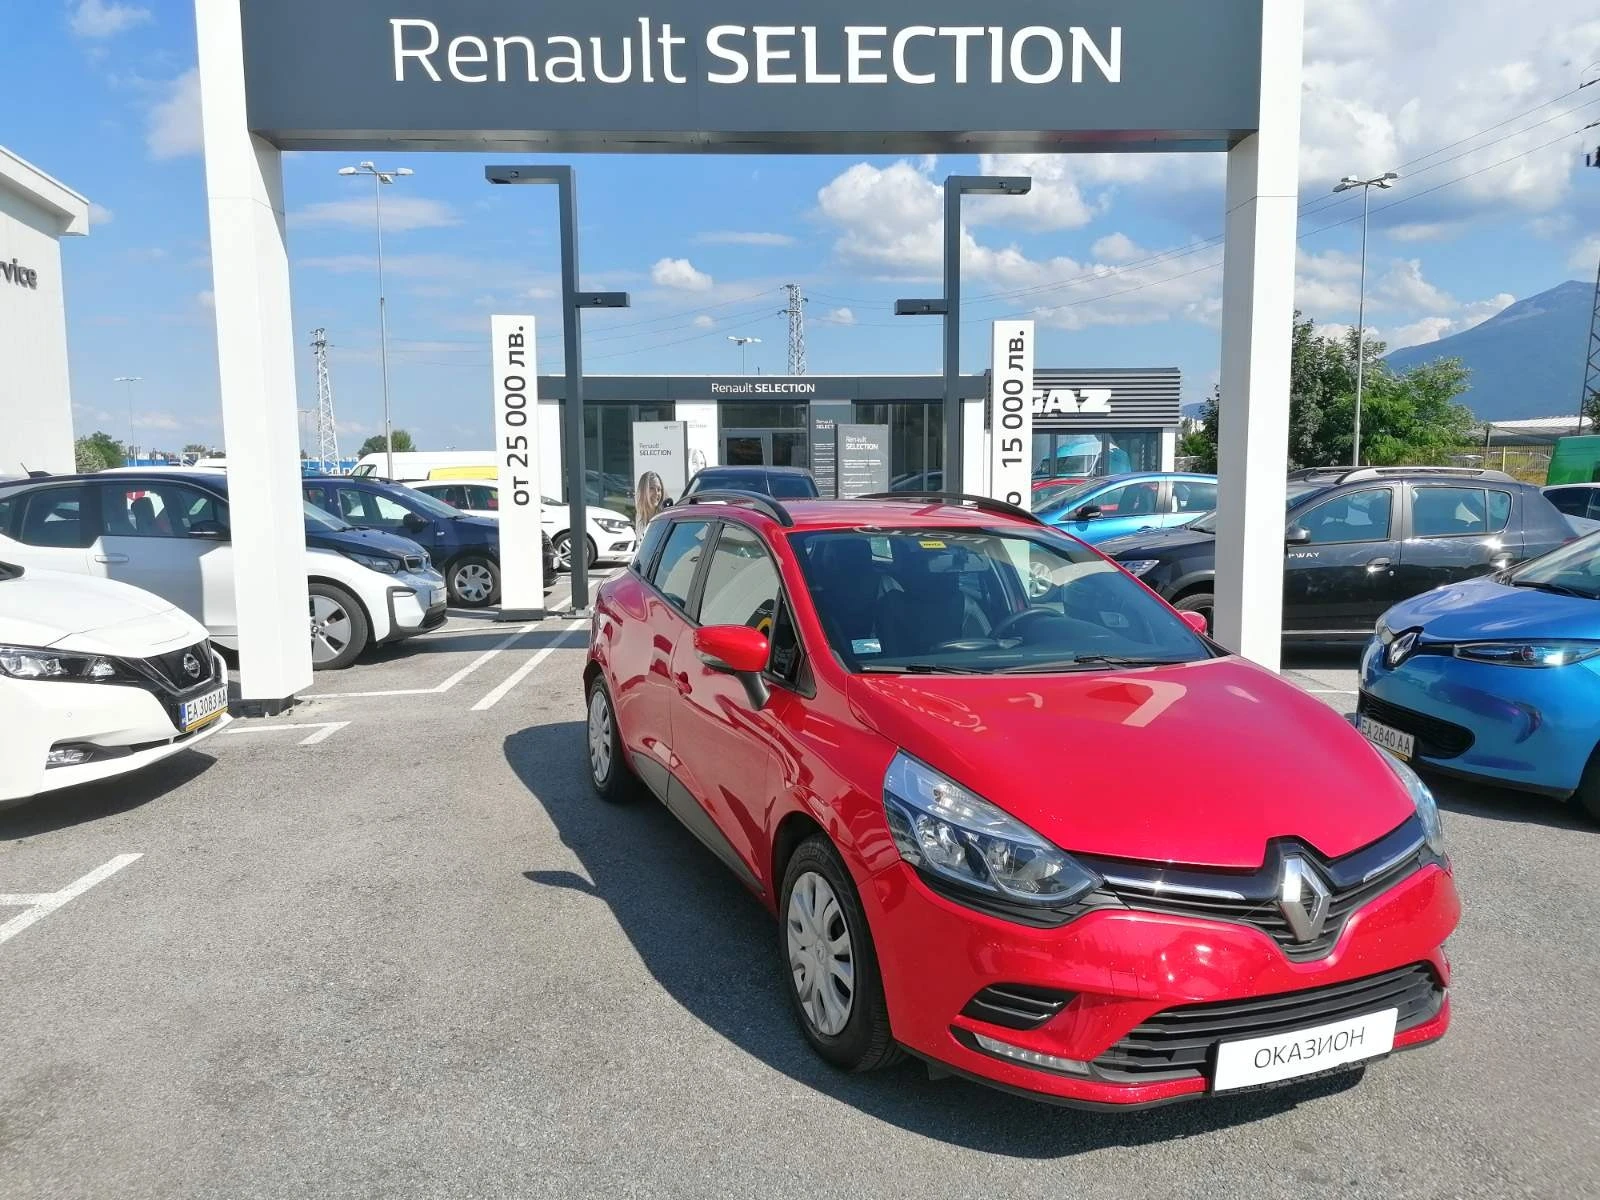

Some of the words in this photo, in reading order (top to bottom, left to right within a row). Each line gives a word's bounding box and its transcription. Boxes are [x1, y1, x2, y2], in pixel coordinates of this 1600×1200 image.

[390, 17, 686, 84] Renault
[706, 25, 1121, 84] SELECTION
[508, 325, 525, 367] лв.
[1009, 330, 1024, 371] лв.
[504, 375, 527, 426] 000
[711, 383, 753, 393] Renault
[755, 383, 816, 393] SELECTION
[1002, 379, 1024, 429] 000
[506, 436, 528, 467] 25
[1002, 437, 1023, 467] 15
[513, 475, 529, 505] от
[199, 694, 217, 717] 3083
[1373, 725, 1396, 747] 2840
[1397, 735, 1411, 755] AA
[1254, 1026, 1365, 1068] ОКАЗИОН
